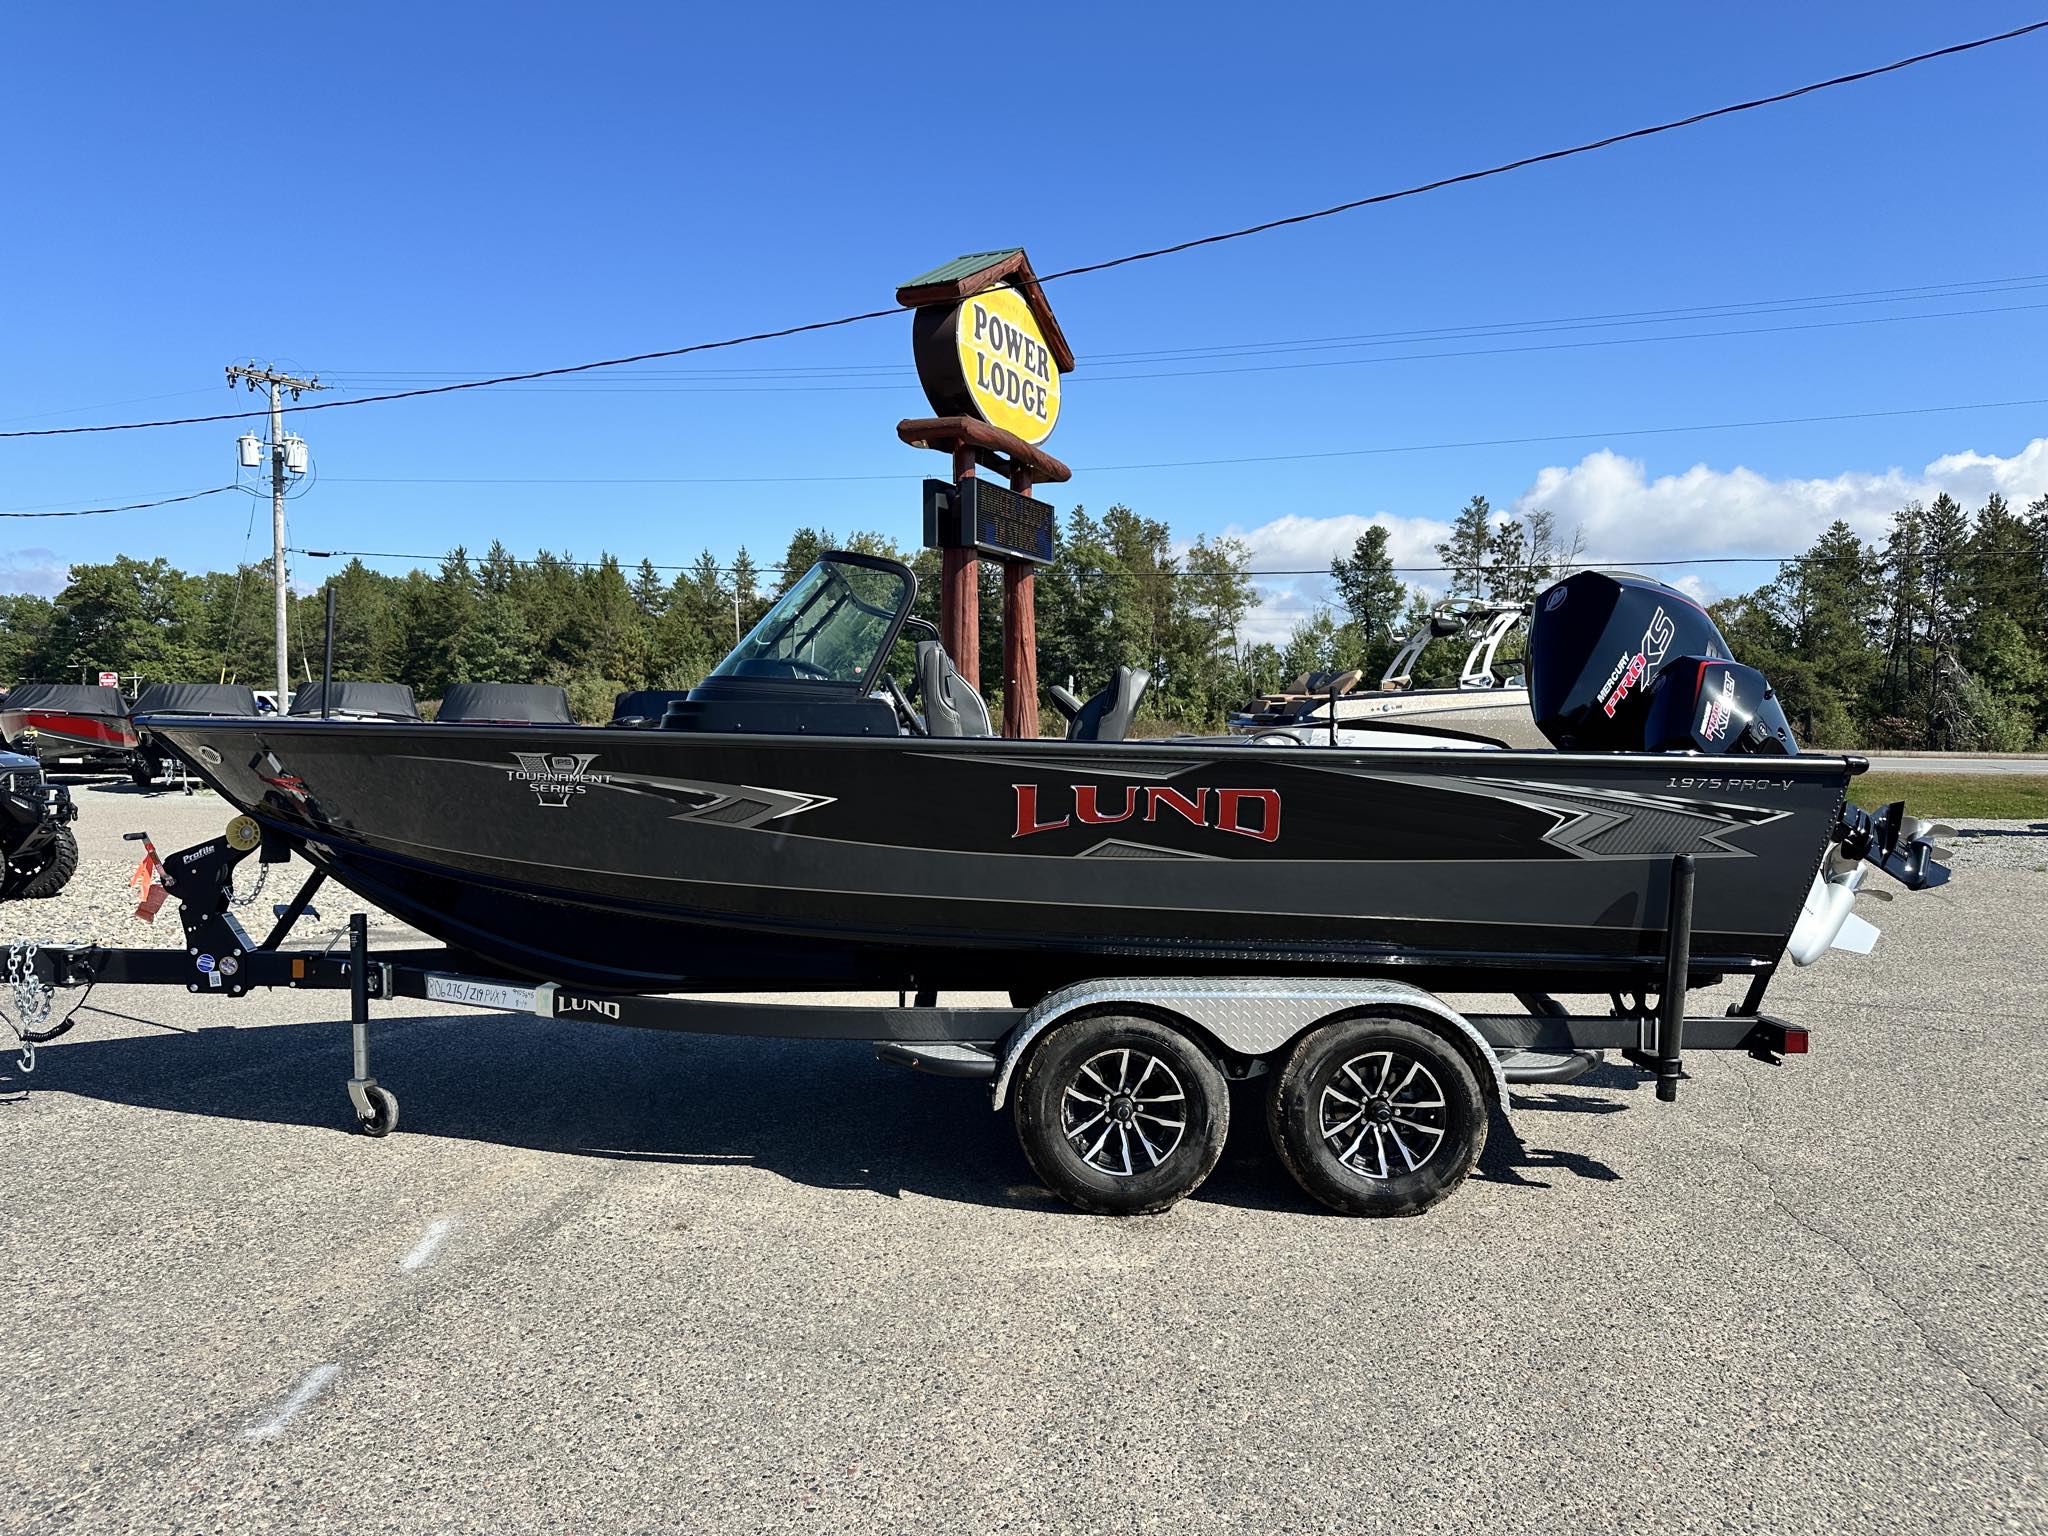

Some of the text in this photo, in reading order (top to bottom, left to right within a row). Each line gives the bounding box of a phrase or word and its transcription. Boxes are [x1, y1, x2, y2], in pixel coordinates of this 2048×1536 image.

[973, 303, 1050, 383] POWER
[976, 351, 1048, 421] LODGE
[1597, 651, 1630, 704] MERCURY
[1603, 605, 1675, 719] PRO XS
[506, 770, 613, 784] TOURNAMENT
[529, 783, 587, 795] SERIES
[1665, 777, 1795, 792] 1975 PRO-V
[1011, 783, 1282, 843] LUND
[182, 845, 215, 863] Profile
[557, 996, 620, 1020] LUND
